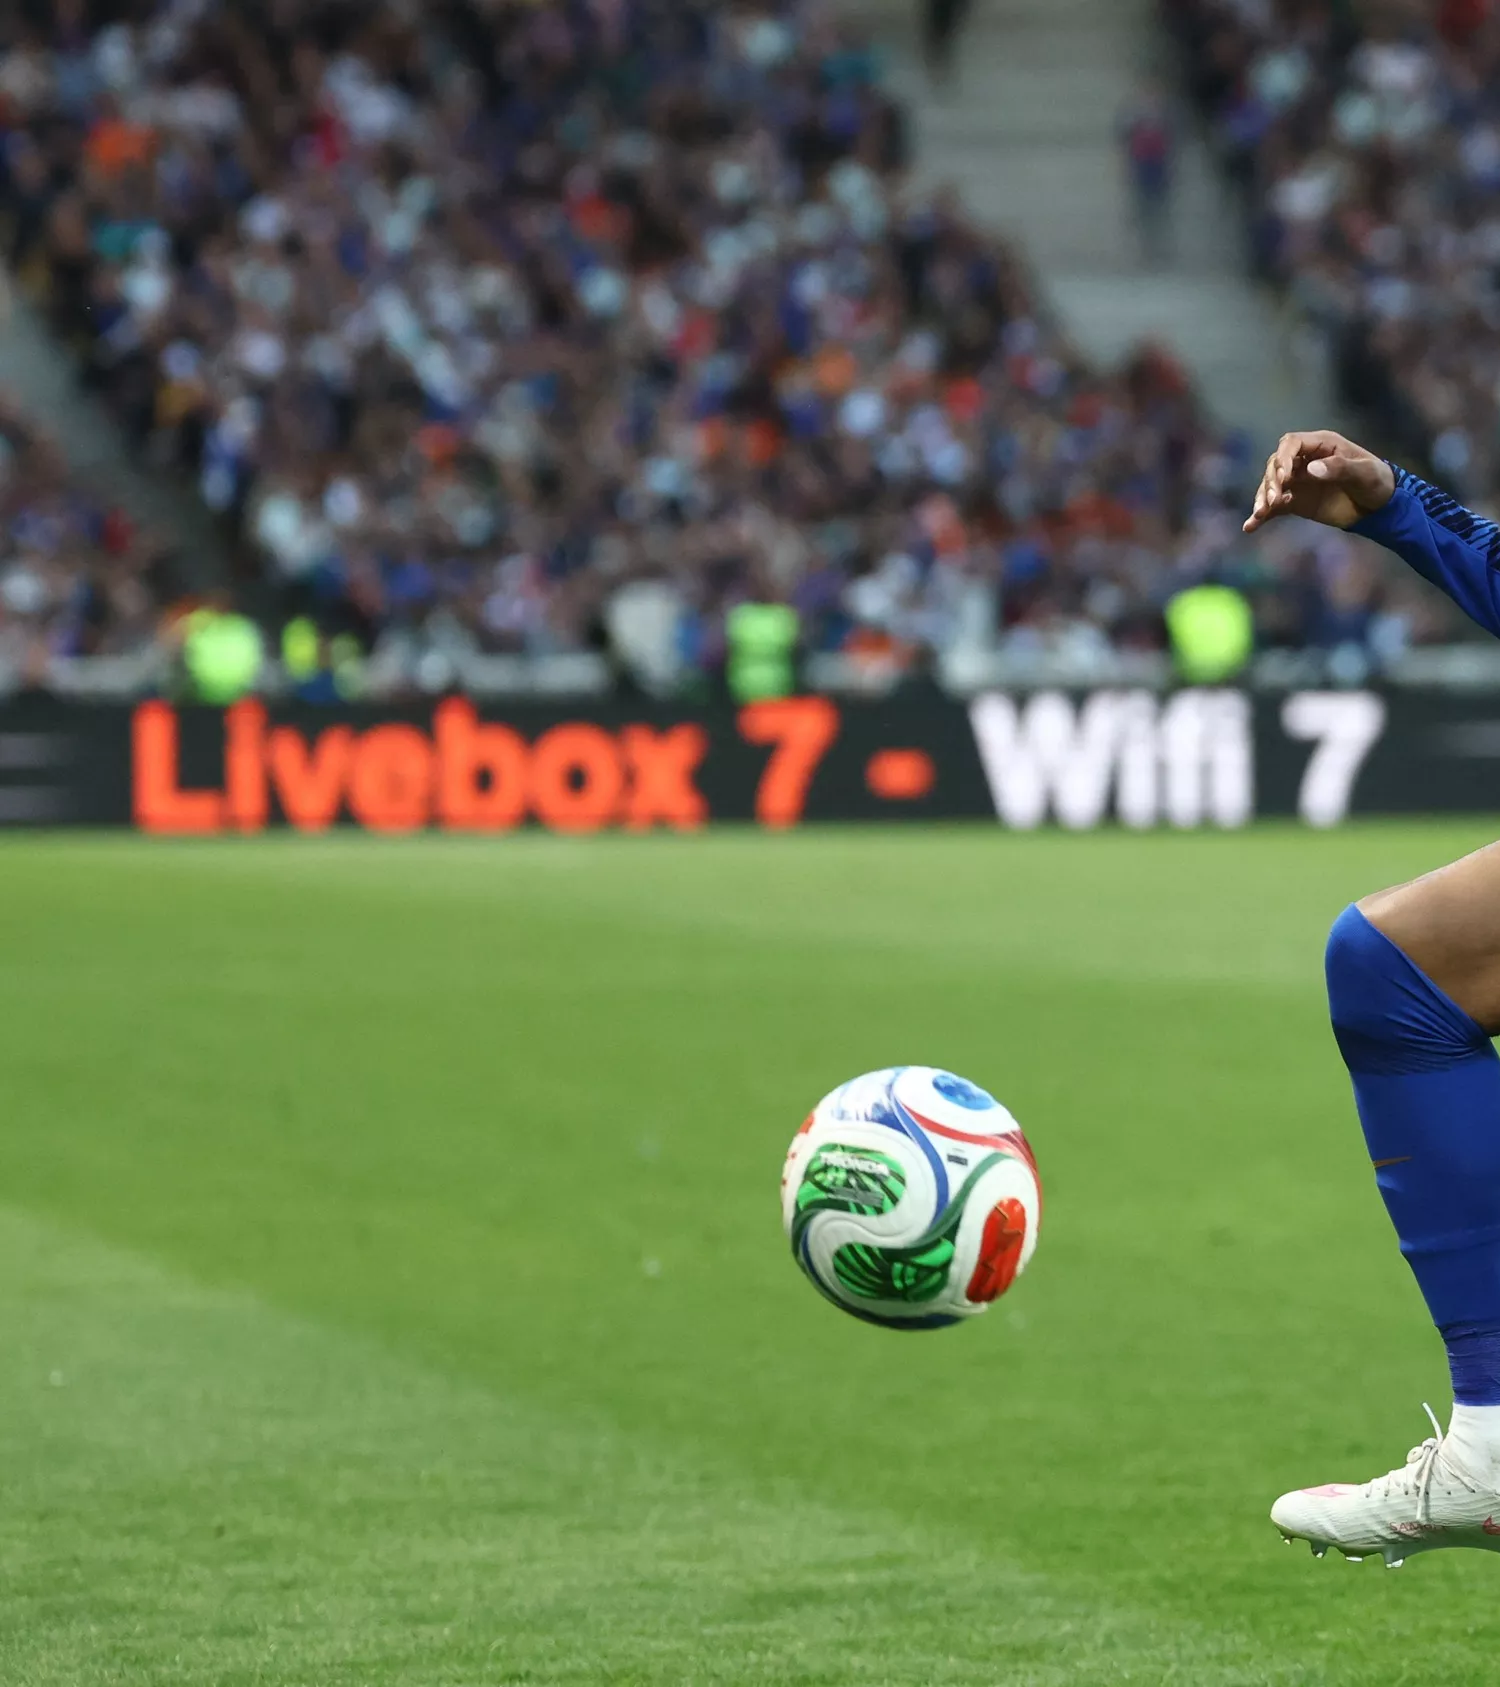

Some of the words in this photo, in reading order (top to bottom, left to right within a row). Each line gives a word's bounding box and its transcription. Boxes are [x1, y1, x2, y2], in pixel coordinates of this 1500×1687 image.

[132, 696, 707, 835] Livebox
[738, 696, 838, 831] 7
[969, 690, 1252, 831] Wifi
[1280, 691, 1386, 830] 7
